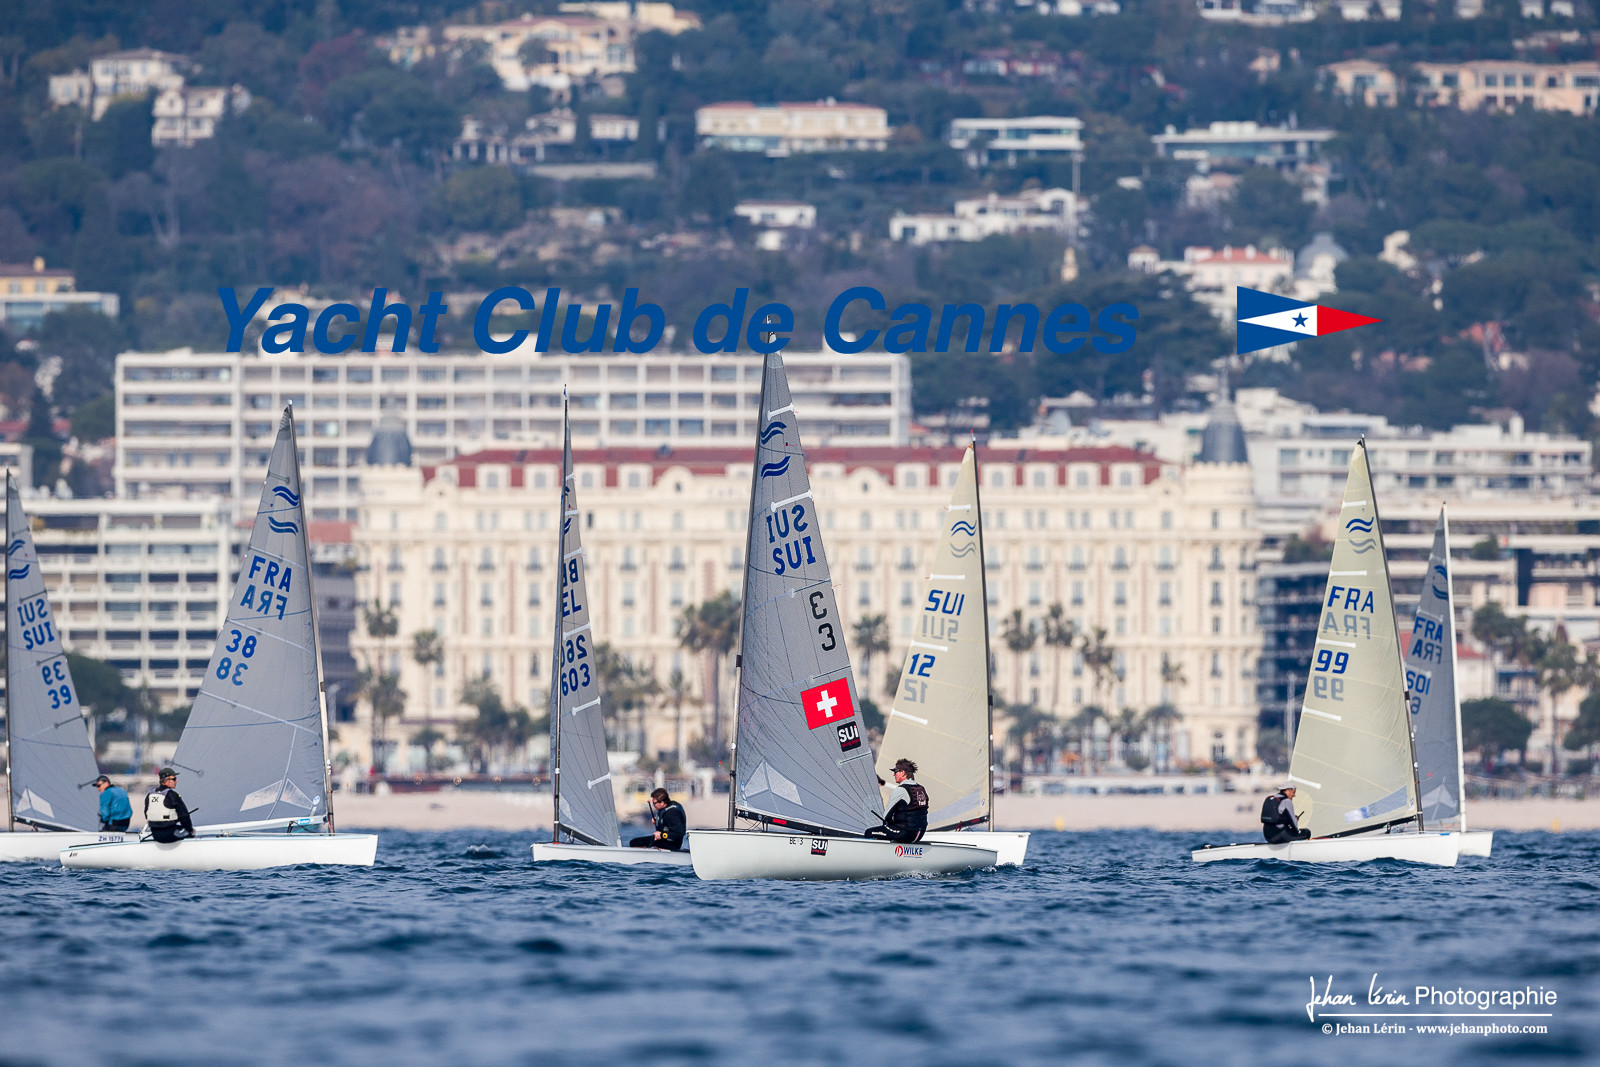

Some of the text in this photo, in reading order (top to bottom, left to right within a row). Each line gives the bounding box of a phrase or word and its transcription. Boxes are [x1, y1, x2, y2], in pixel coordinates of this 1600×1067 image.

[772, 536, 816, 575] SUI
[249, 555, 292, 592] FRA
[563, 589, 582, 617] EL
[925, 589, 965, 616] SUI
[1327, 585, 1374, 614] FRA
[23, 621, 55, 650] SUI
[226, 629, 257, 658] 38
[818, 623, 836, 651] 3
[1413, 616, 1443, 643] FRA
[909, 653, 936, 678] 12
[1315, 649, 1349, 674] 99
[561, 663, 590, 696] 603
[48, 685, 72, 709] 39
[904, 847, 923, 855] WILKE
